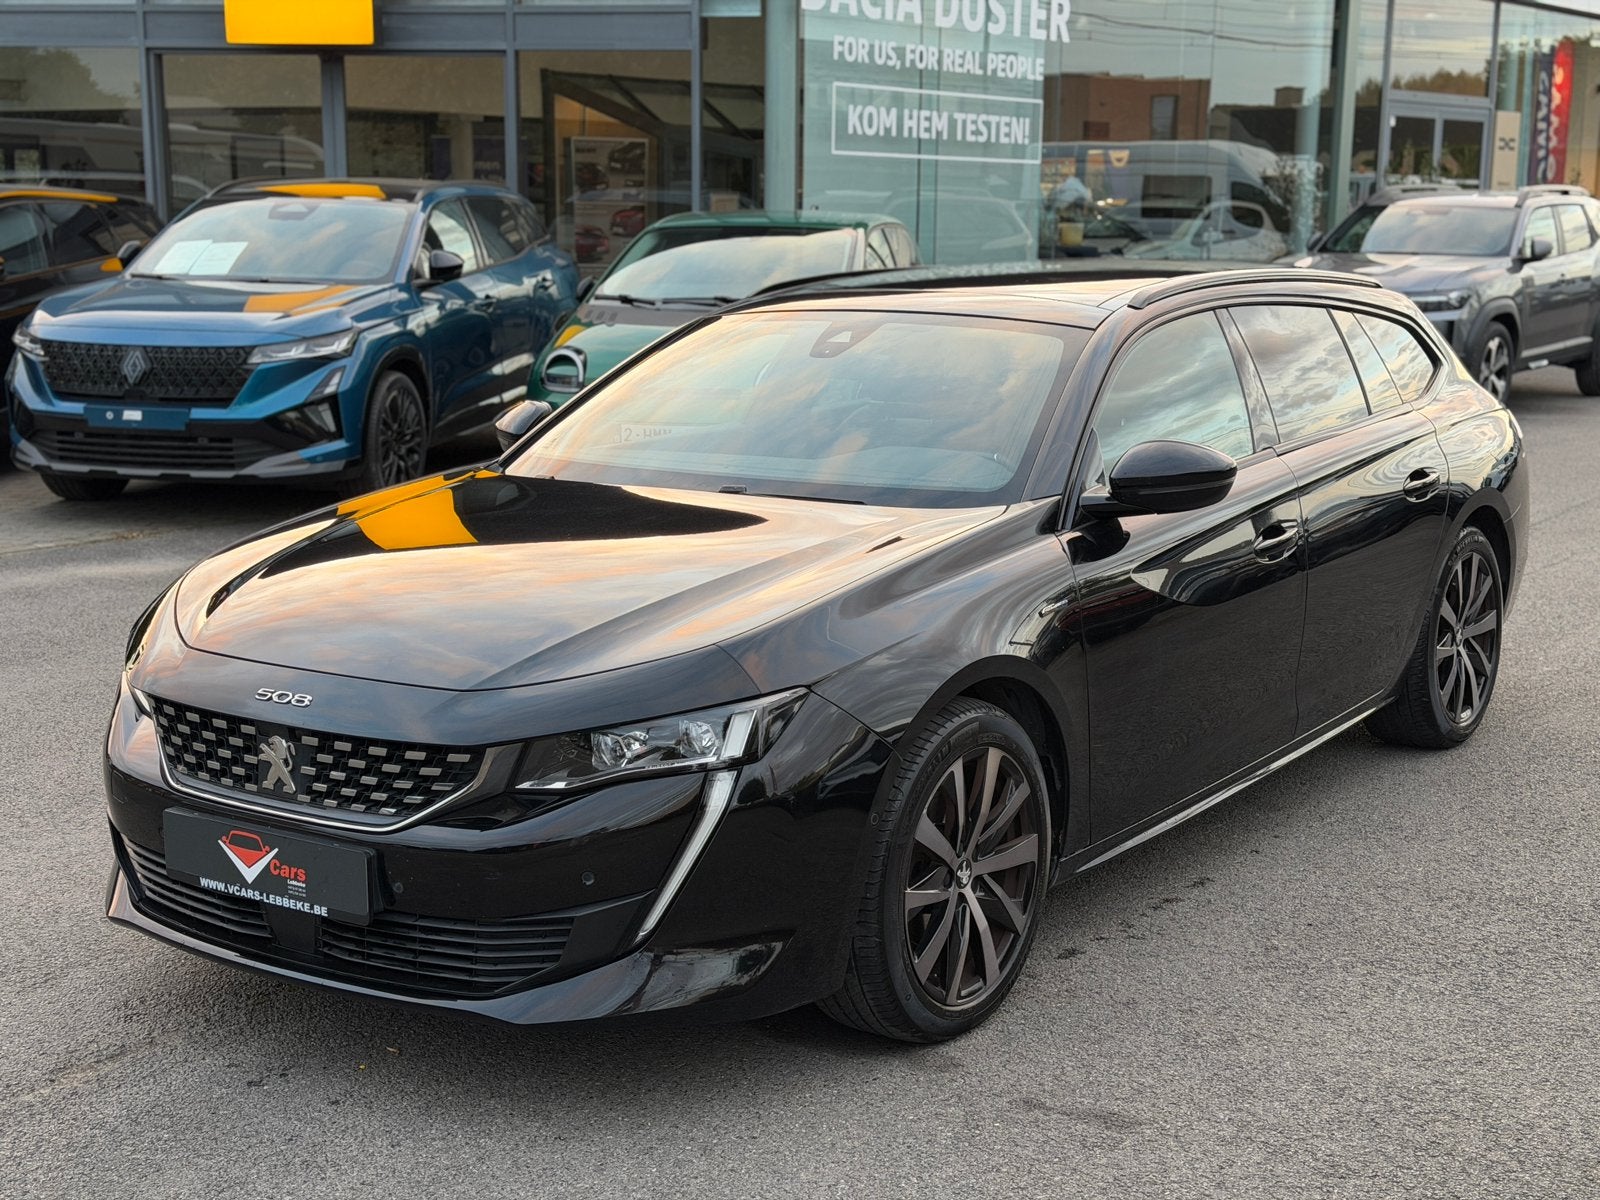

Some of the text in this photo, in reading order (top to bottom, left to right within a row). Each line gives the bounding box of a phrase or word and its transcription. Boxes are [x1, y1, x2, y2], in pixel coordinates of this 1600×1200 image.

[833, 35, 1044, 81] FOR US, FOR REAL PEOPLE
[848, 104, 1030, 145] KOM HEM TESTEN!
[255, 688, 312, 706] 508
[270, 858, 306, 881] Cars
[200, 877, 328, 917] WWW.VCARS-LEBBEKE.BE
